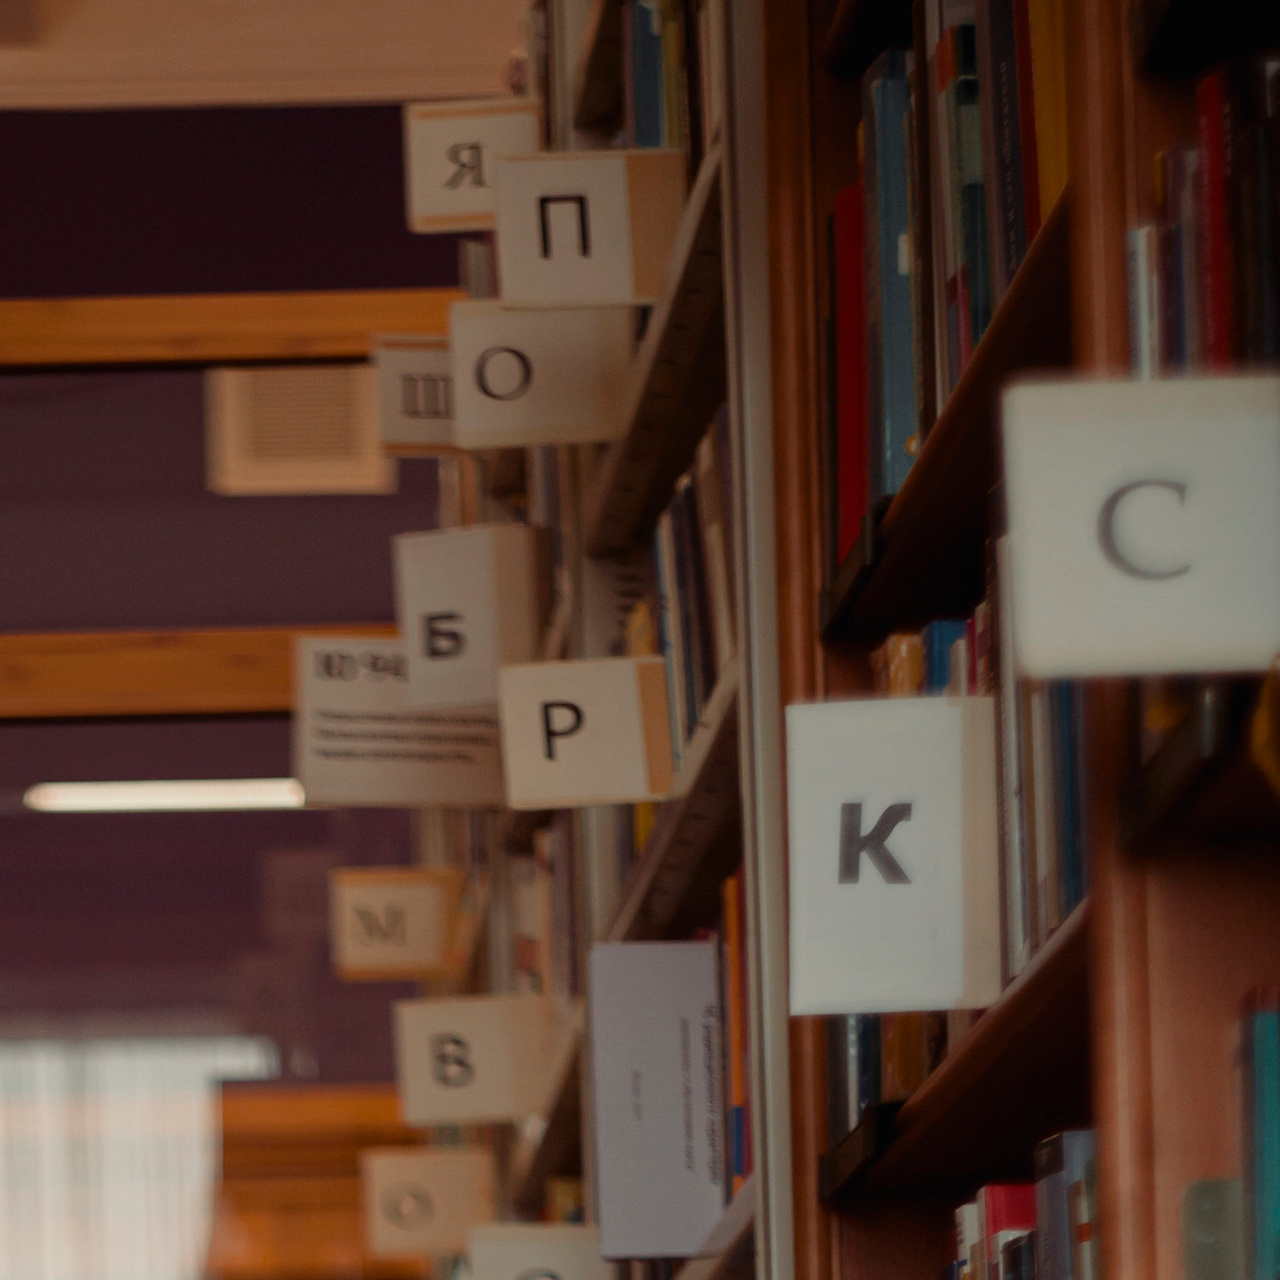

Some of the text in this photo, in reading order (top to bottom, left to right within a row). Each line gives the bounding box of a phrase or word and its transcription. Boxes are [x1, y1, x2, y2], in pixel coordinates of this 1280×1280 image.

[444, 140, 487, 191] Я
[537, 193, 591, 259] П
[475, 345, 533, 401] О
[1096, 477, 1192, 581] С
[422, 611, 466, 660] Б
[541, 700, 585, 761] Р
[836, 801, 914, 885] К
